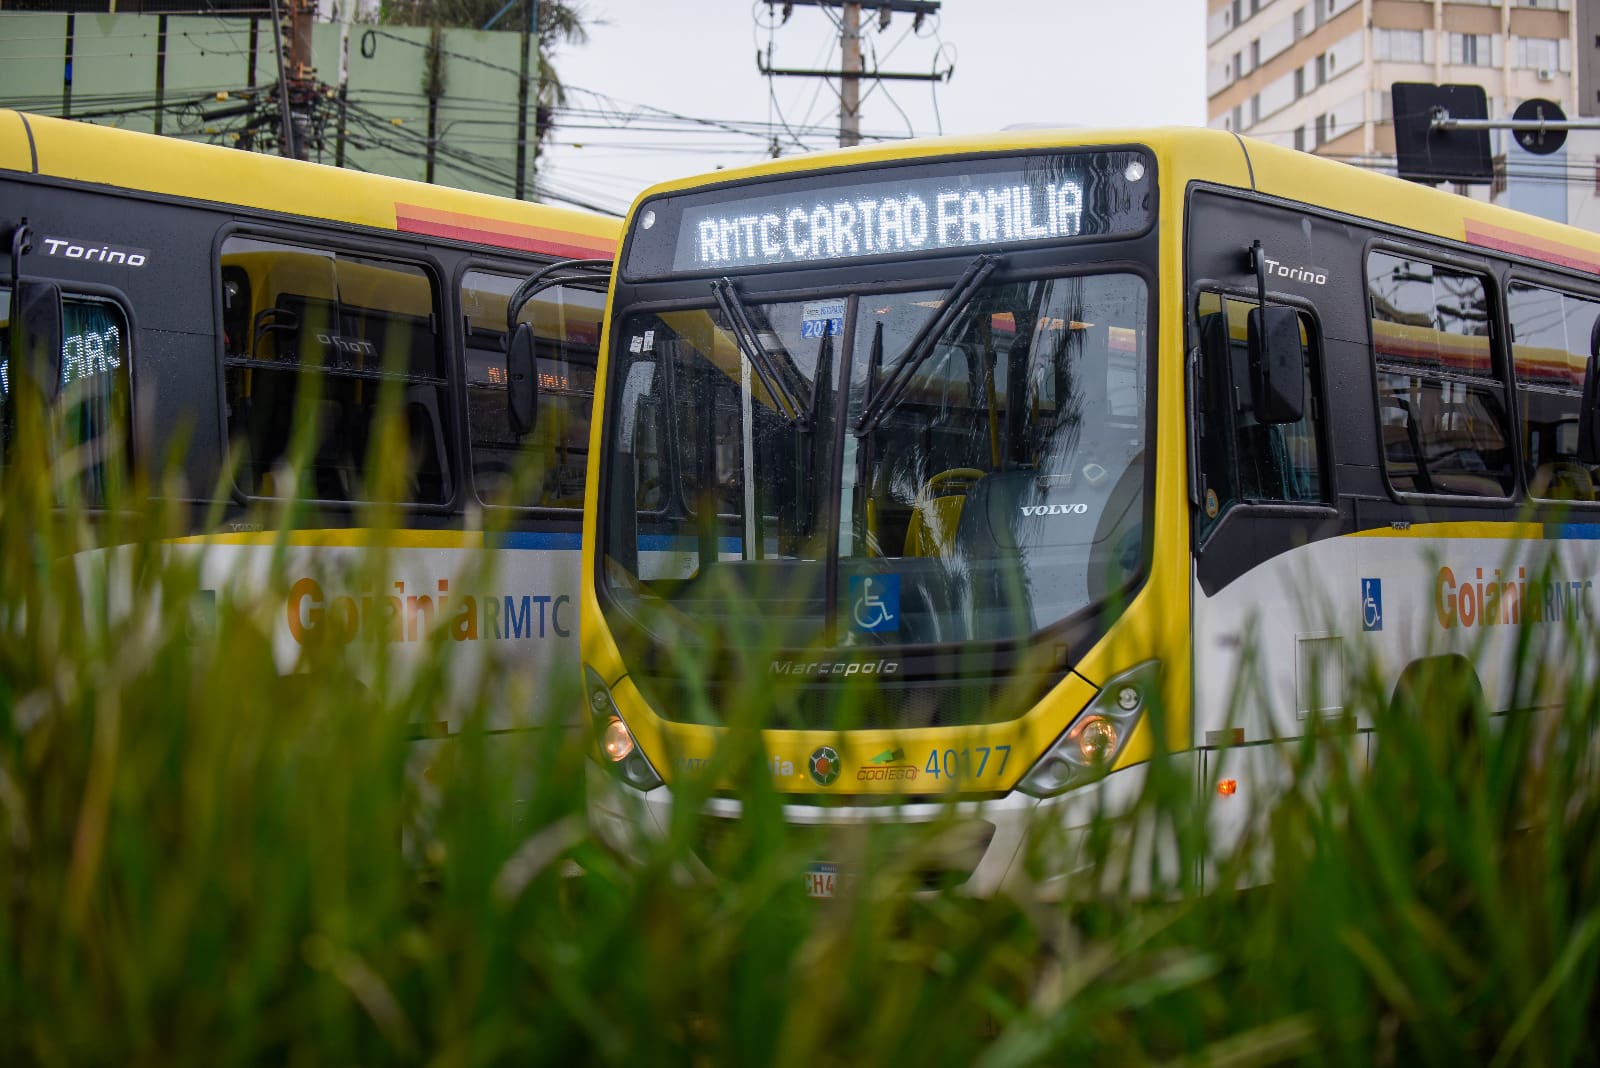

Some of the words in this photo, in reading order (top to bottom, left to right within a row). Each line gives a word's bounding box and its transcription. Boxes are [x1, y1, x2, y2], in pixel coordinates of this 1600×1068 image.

[698, 214, 781, 262] RMTC
[786, 193, 928, 257] CARTAO
[936, 181, 1083, 244] FAMILIA
[44, 238, 146, 267] Torino
[1264, 259, 1327, 285] Torino
[1020, 503, 1089, 517] VOLVO
[482, 594, 570, 641] RMTC
[768, 659, 899, 677] Marcopolo
[925, 745, 1012, 779] 40177
